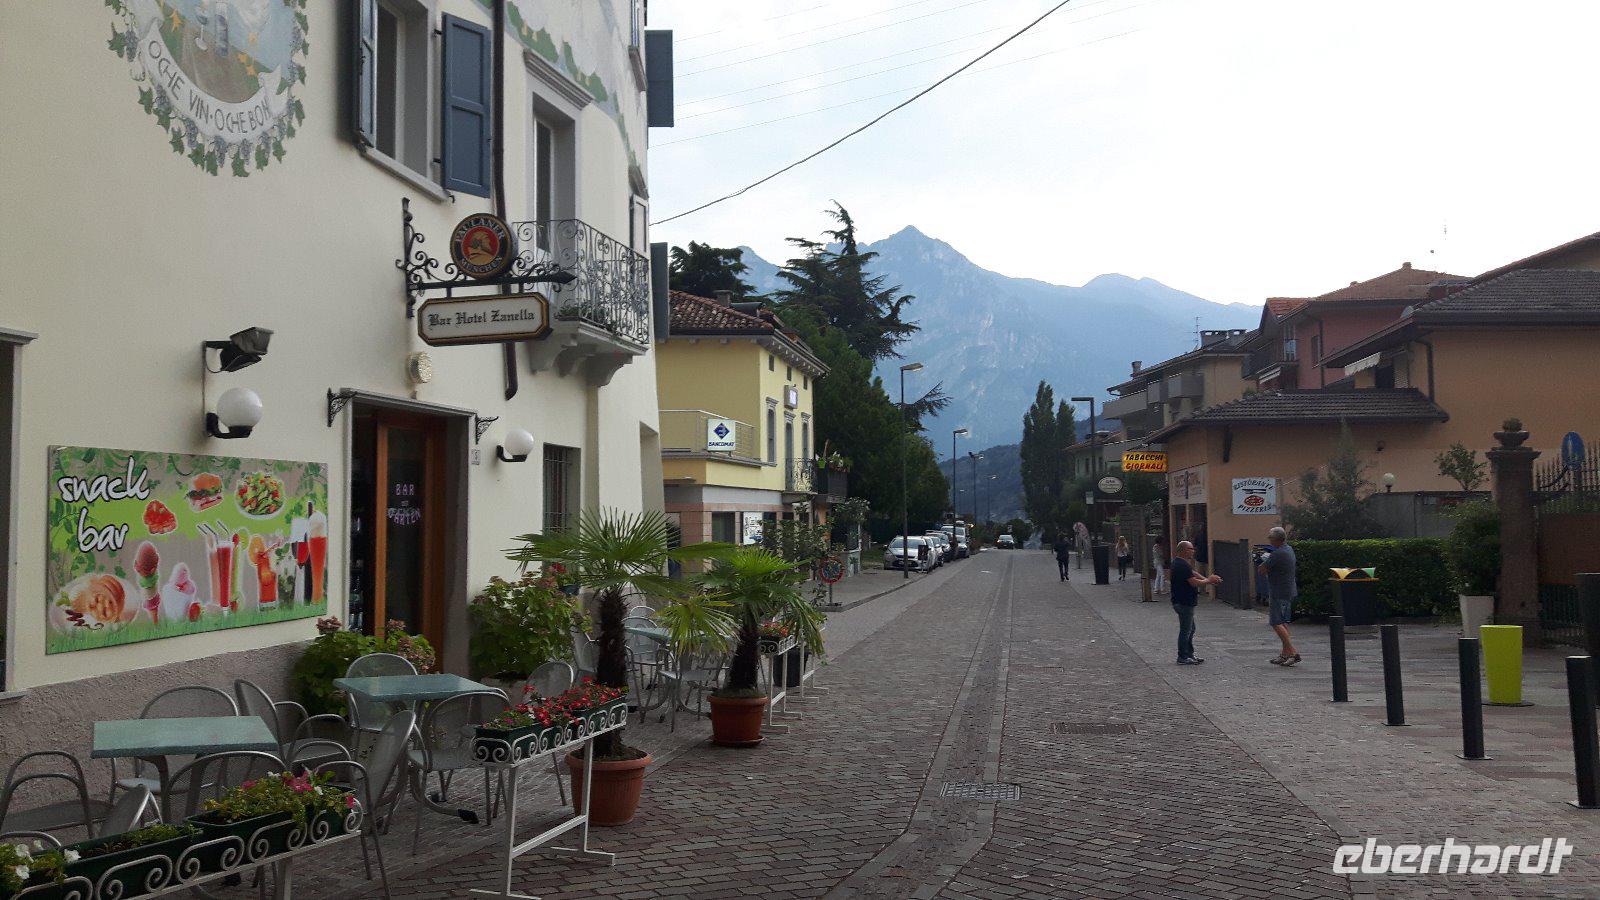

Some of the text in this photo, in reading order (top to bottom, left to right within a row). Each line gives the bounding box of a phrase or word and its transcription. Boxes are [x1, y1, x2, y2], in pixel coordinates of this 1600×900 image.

[149, 40, 184, 101] OCHE
[214, 108, 248, 134] OCHE
[427, 309, 535, 331] Bar Hotel Zanella
[57, 455, 151, 503] snack
[395, 483, 415, 496] BAR
[1237, 504, 1272, 513] PIZZERIA
[77, 507, 129, 553] bar
